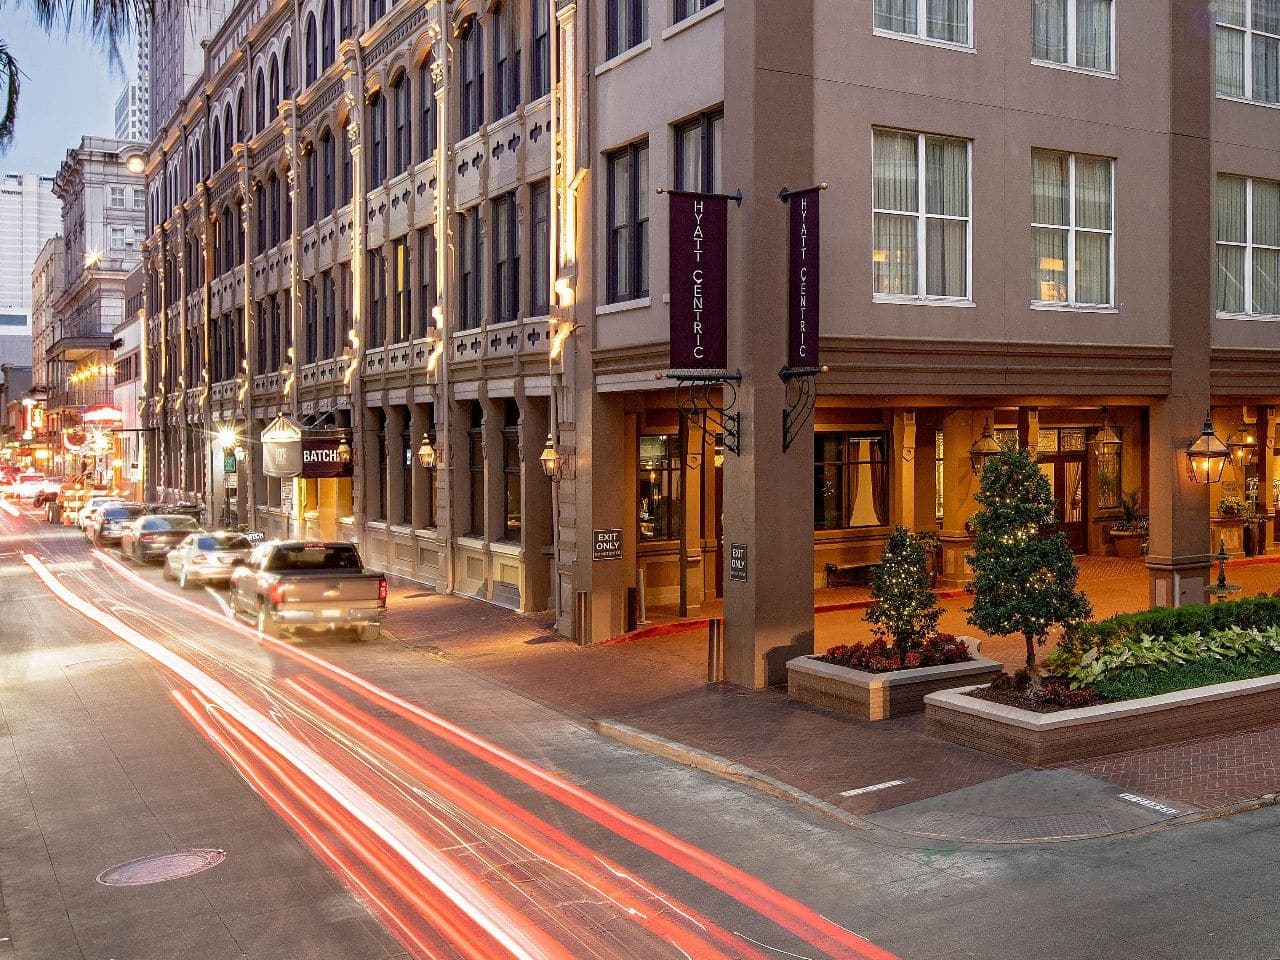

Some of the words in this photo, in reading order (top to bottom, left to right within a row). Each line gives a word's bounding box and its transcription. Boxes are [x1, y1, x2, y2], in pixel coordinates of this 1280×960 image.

[693, 200, 703, 262] HYATT
[692, 270, 704, 359] CENTRIC
[799, 267, 807, 358] CENTRIC
[303, 450, 336, 462] BATCH
[598, 532, 618, 541] EXIT
[596, 541, 621, 550] ONLY
[732, 548, 744, 558] EXIT
[731, 559, 746, 569] ONLY
